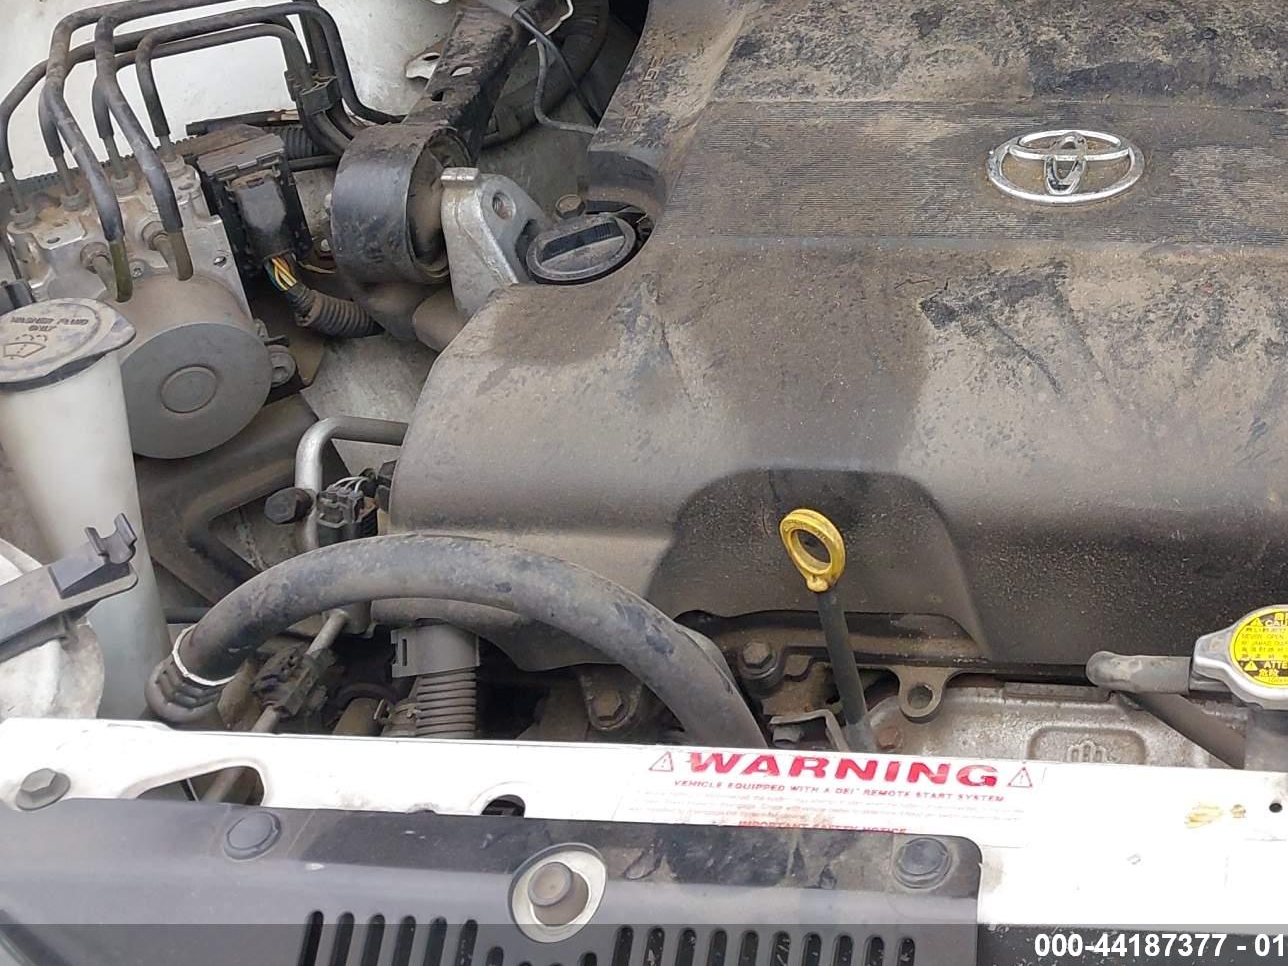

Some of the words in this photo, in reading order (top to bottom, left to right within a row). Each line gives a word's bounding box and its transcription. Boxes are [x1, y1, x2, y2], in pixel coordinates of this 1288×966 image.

[688, 751, 999, 787] WARNING
[673, 779, 723, 789] VEHICLE
[727, 781, 786, 792] EQUIPPED
[789, 784, 819, 794] WITH
[862, 789, 911, 798] REMOTE
[915, 791, 954, 801] START
[956, 793, 1005, 803] SYSTEM
